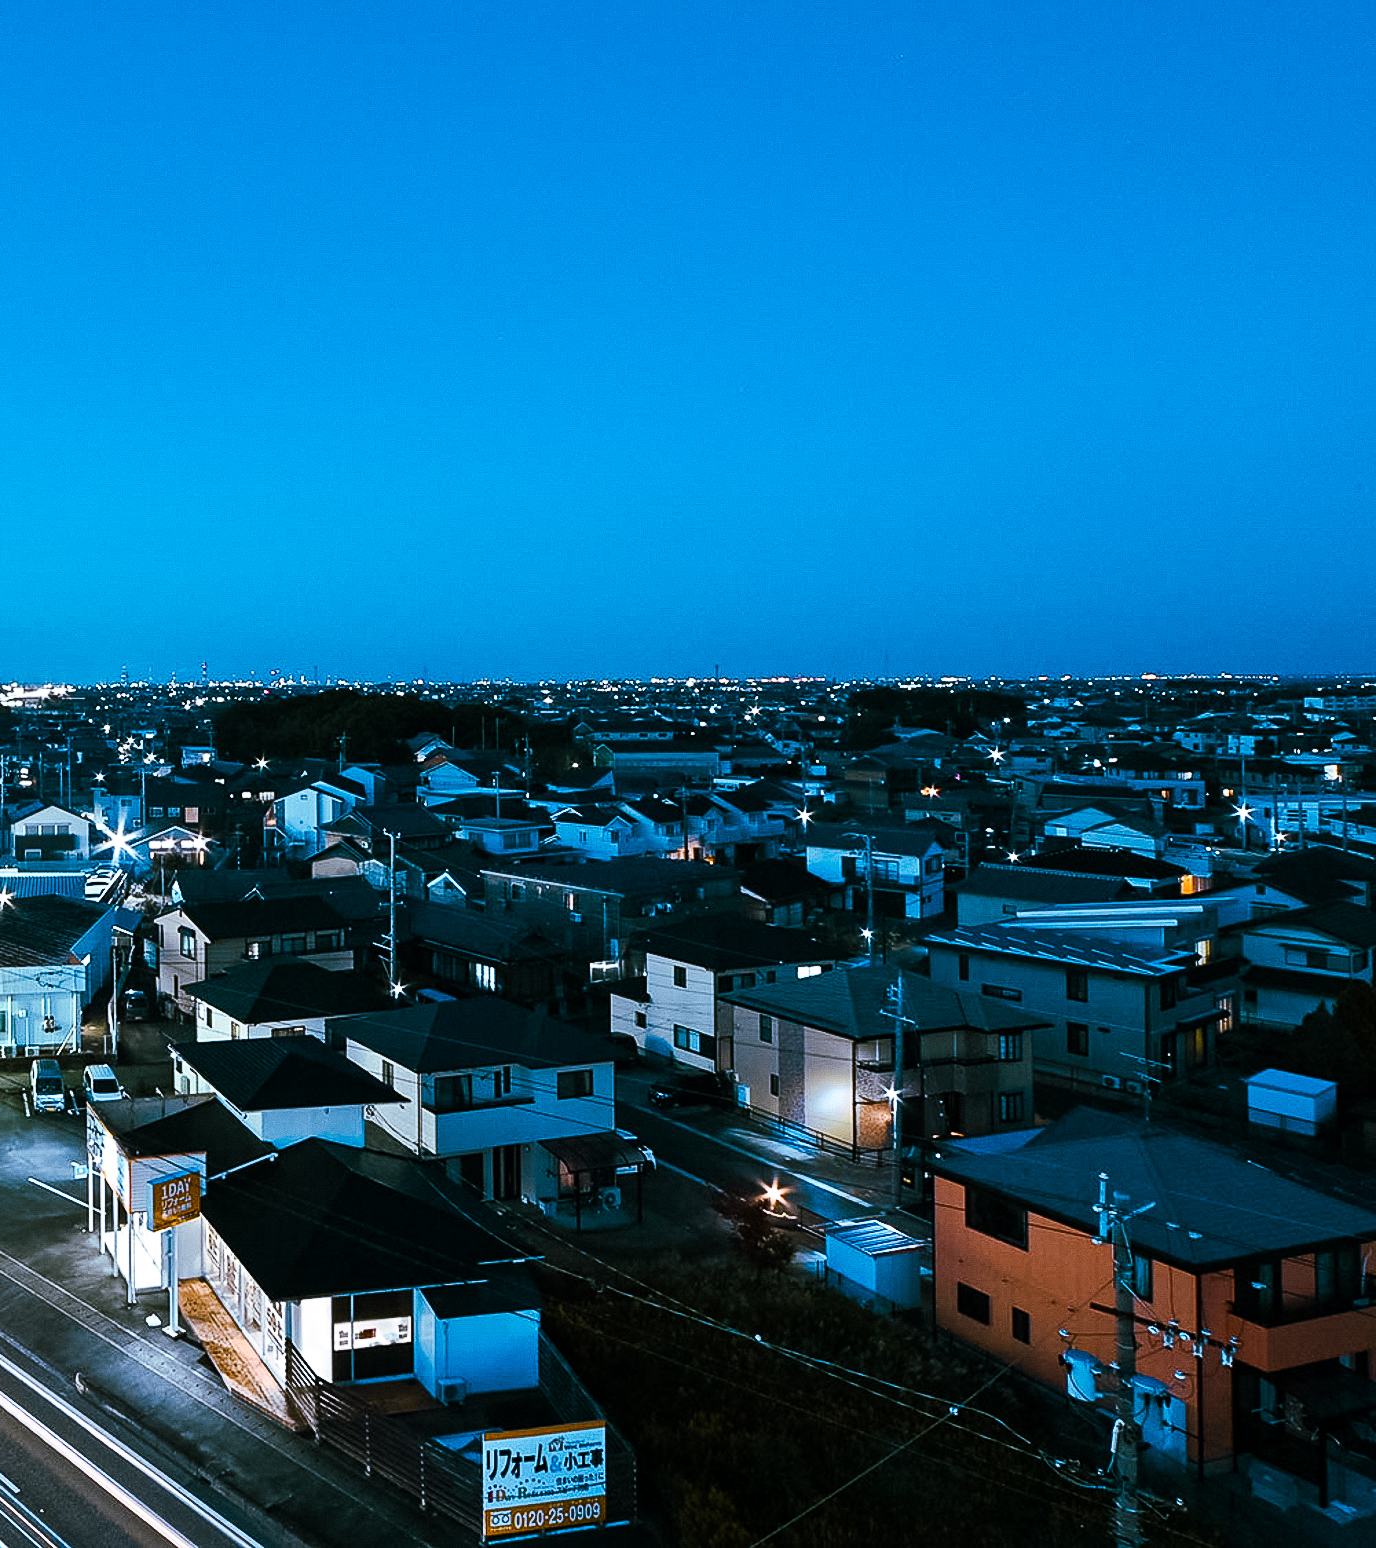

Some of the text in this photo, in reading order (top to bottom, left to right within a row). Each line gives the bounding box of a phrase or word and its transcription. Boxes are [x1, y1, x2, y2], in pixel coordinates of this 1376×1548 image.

[486, 1443, 548, 1481] リフォーム
[550, 1455, 563, 1472] &
